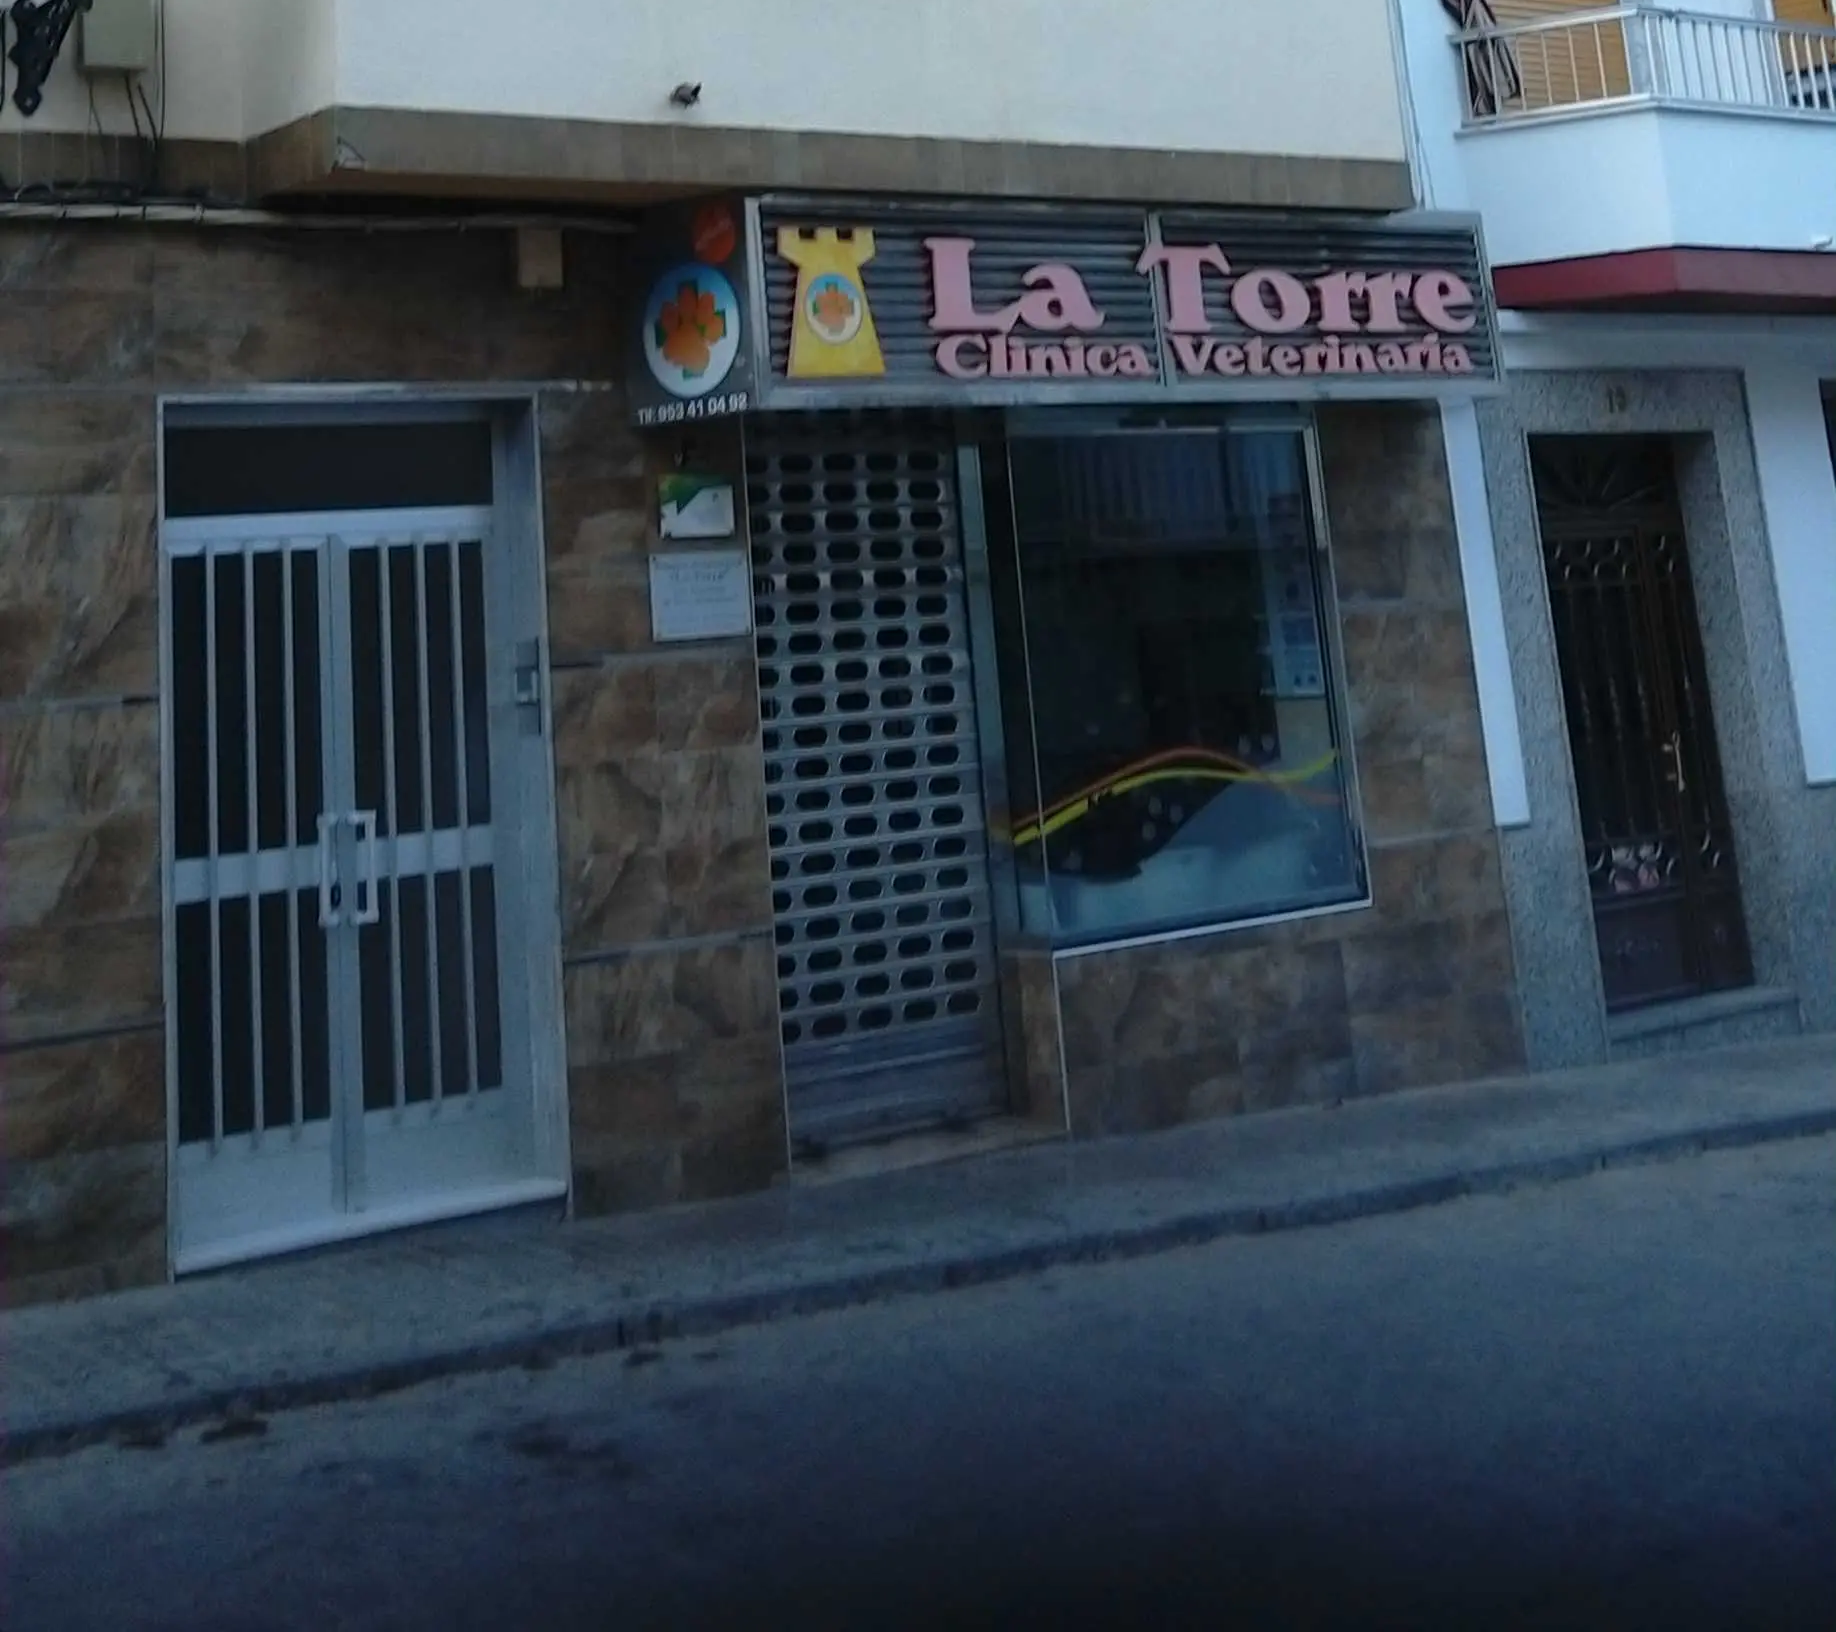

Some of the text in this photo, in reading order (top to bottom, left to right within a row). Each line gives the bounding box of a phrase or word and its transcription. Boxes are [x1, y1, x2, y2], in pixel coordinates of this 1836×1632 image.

[923, 236, 1476, 333] La Torre
[1171, 333, 1475, 377] Veterinaria
[686, 398, 705, 418] 41
